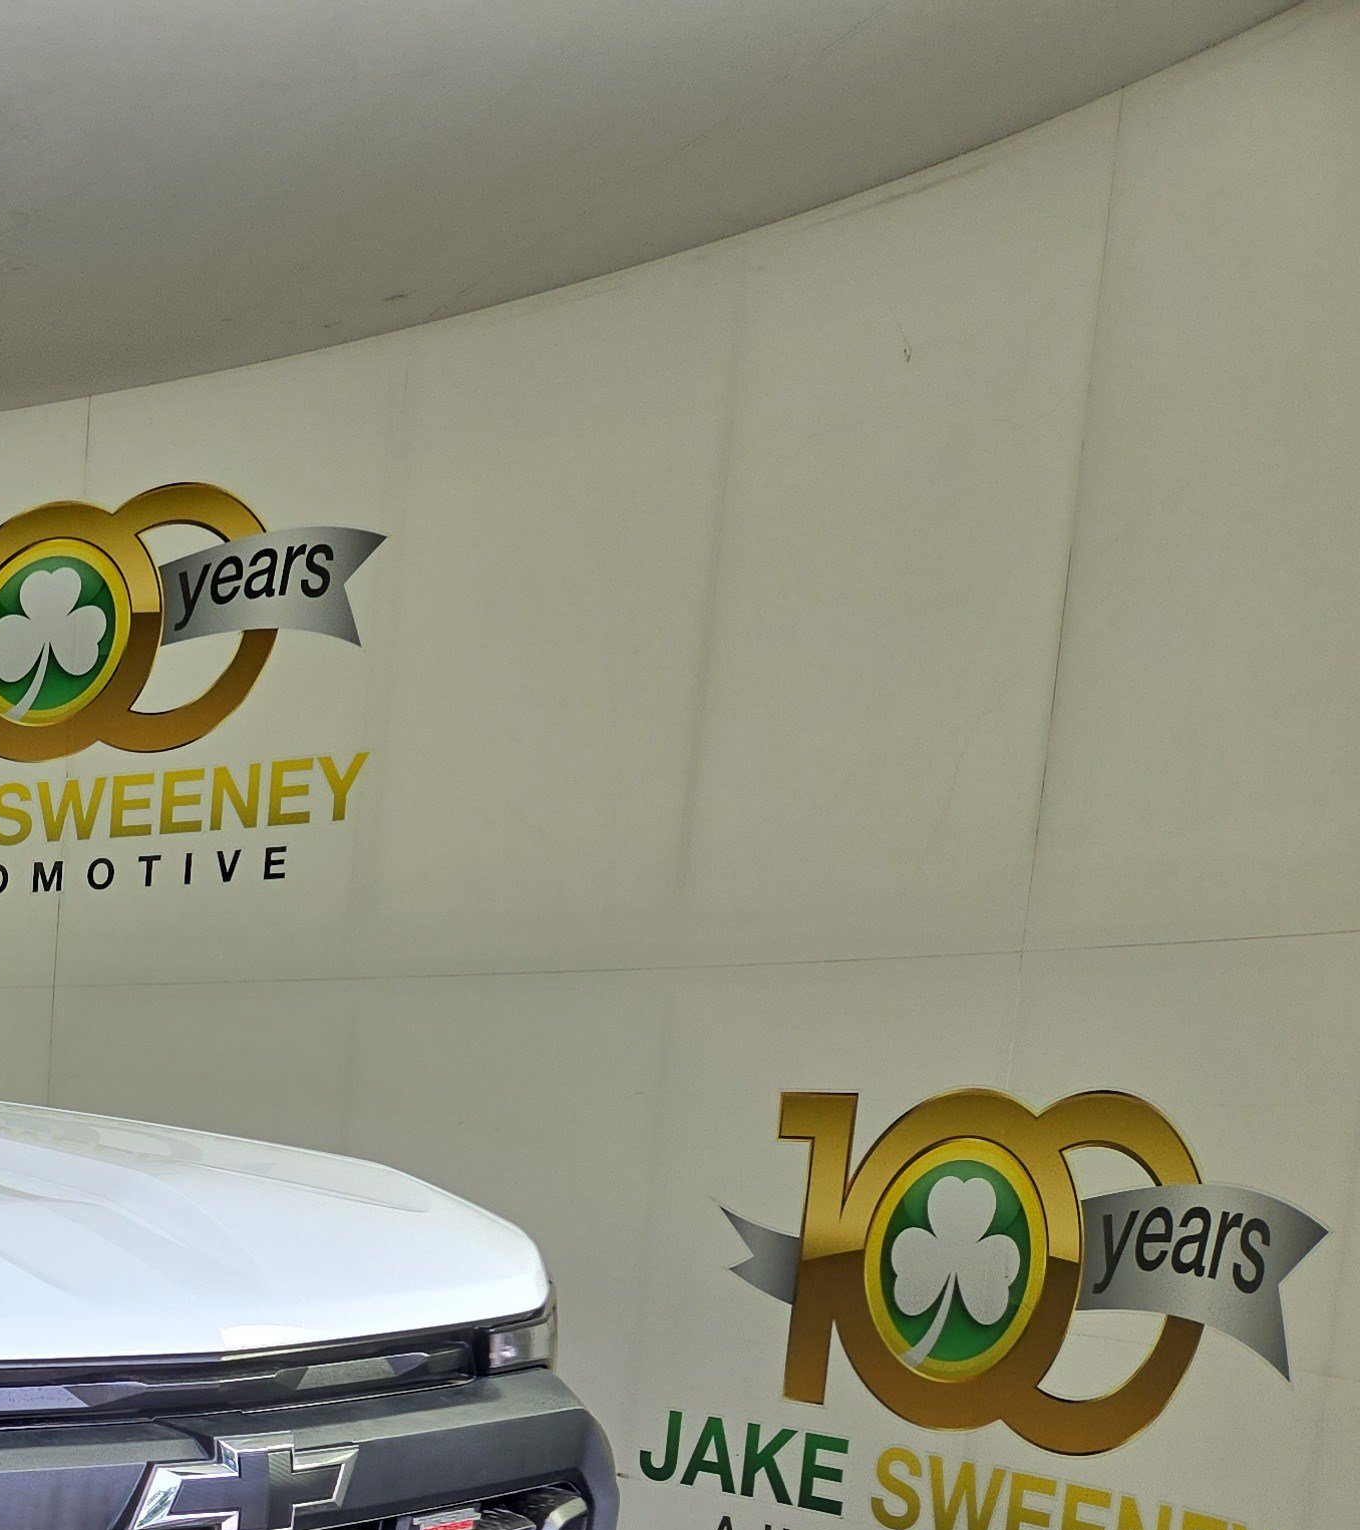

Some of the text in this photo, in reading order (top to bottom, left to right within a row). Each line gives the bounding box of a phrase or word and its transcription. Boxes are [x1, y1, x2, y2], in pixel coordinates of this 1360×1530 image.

[174, 541, 335, 632] years
[1092, 1205, 1273, 1294] years
[638, 1409, 850, 1517] JAKE
